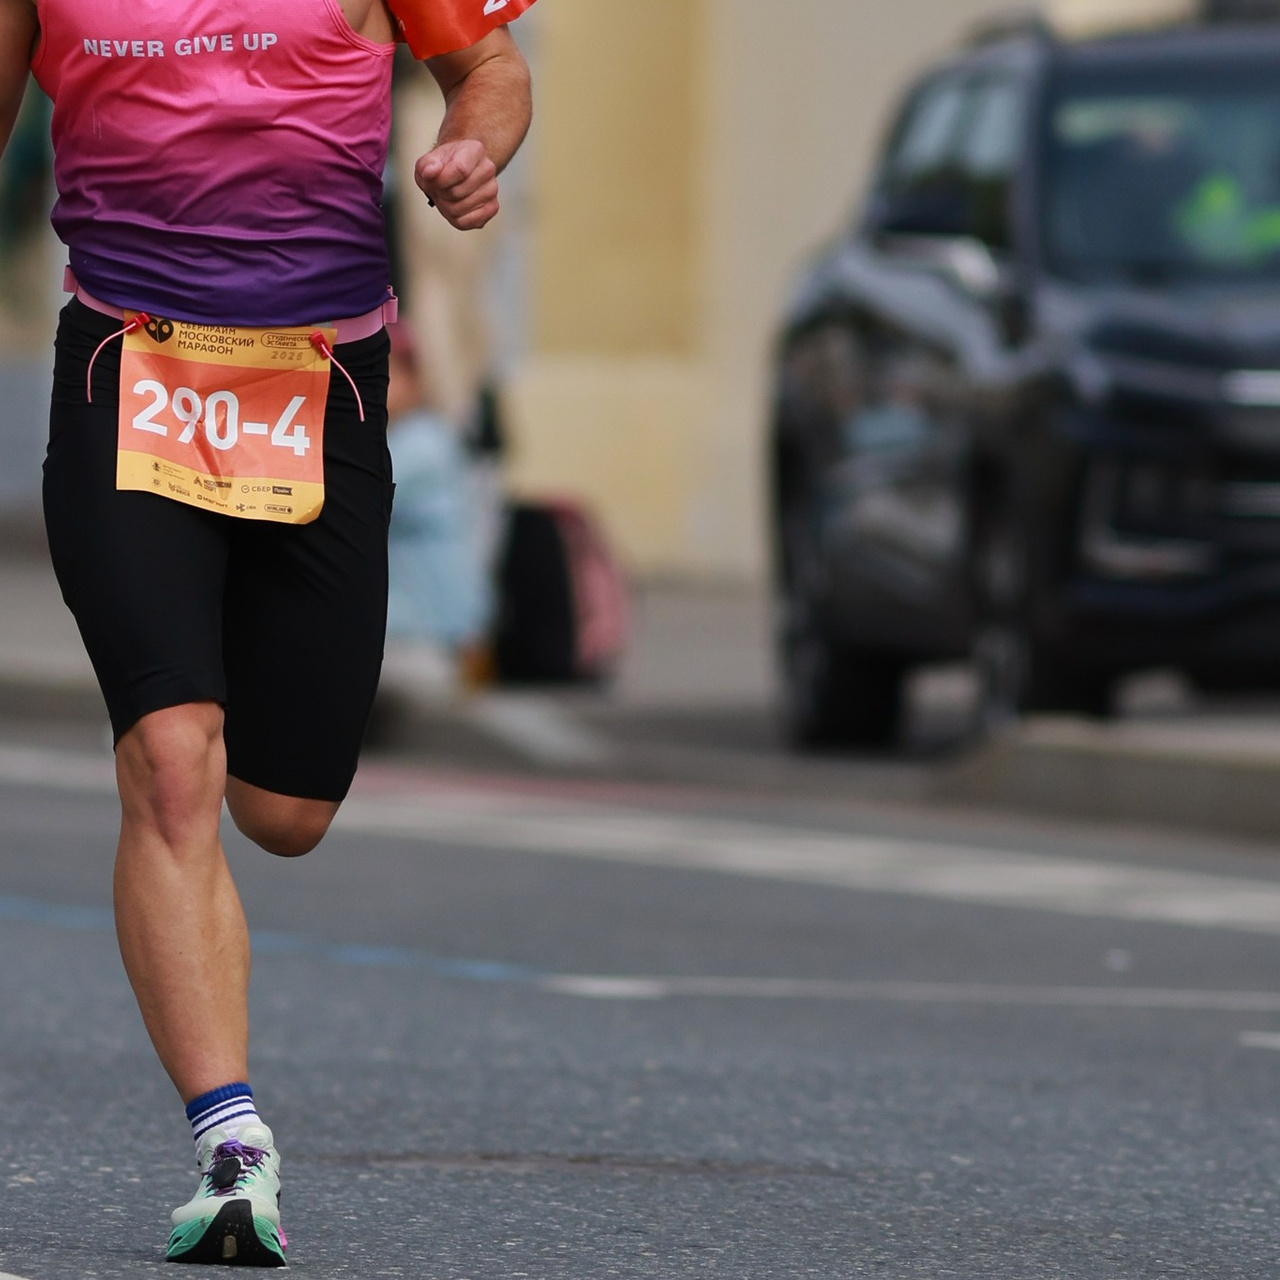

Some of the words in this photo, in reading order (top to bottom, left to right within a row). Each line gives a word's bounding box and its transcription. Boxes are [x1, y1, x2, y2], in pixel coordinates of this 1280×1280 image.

[83, 38, 165, 58] NEVER
[175, 34, 233, 56] GIVE
[243, 33, 278, 51] UP
[177, 340, 234, 356] МАРАФОН
[178, 330, 255, 348] МОСКОВСКИЙ
[131, 379, 311, 457] 290-4
[251, 485, 272, 493] СБЕР
